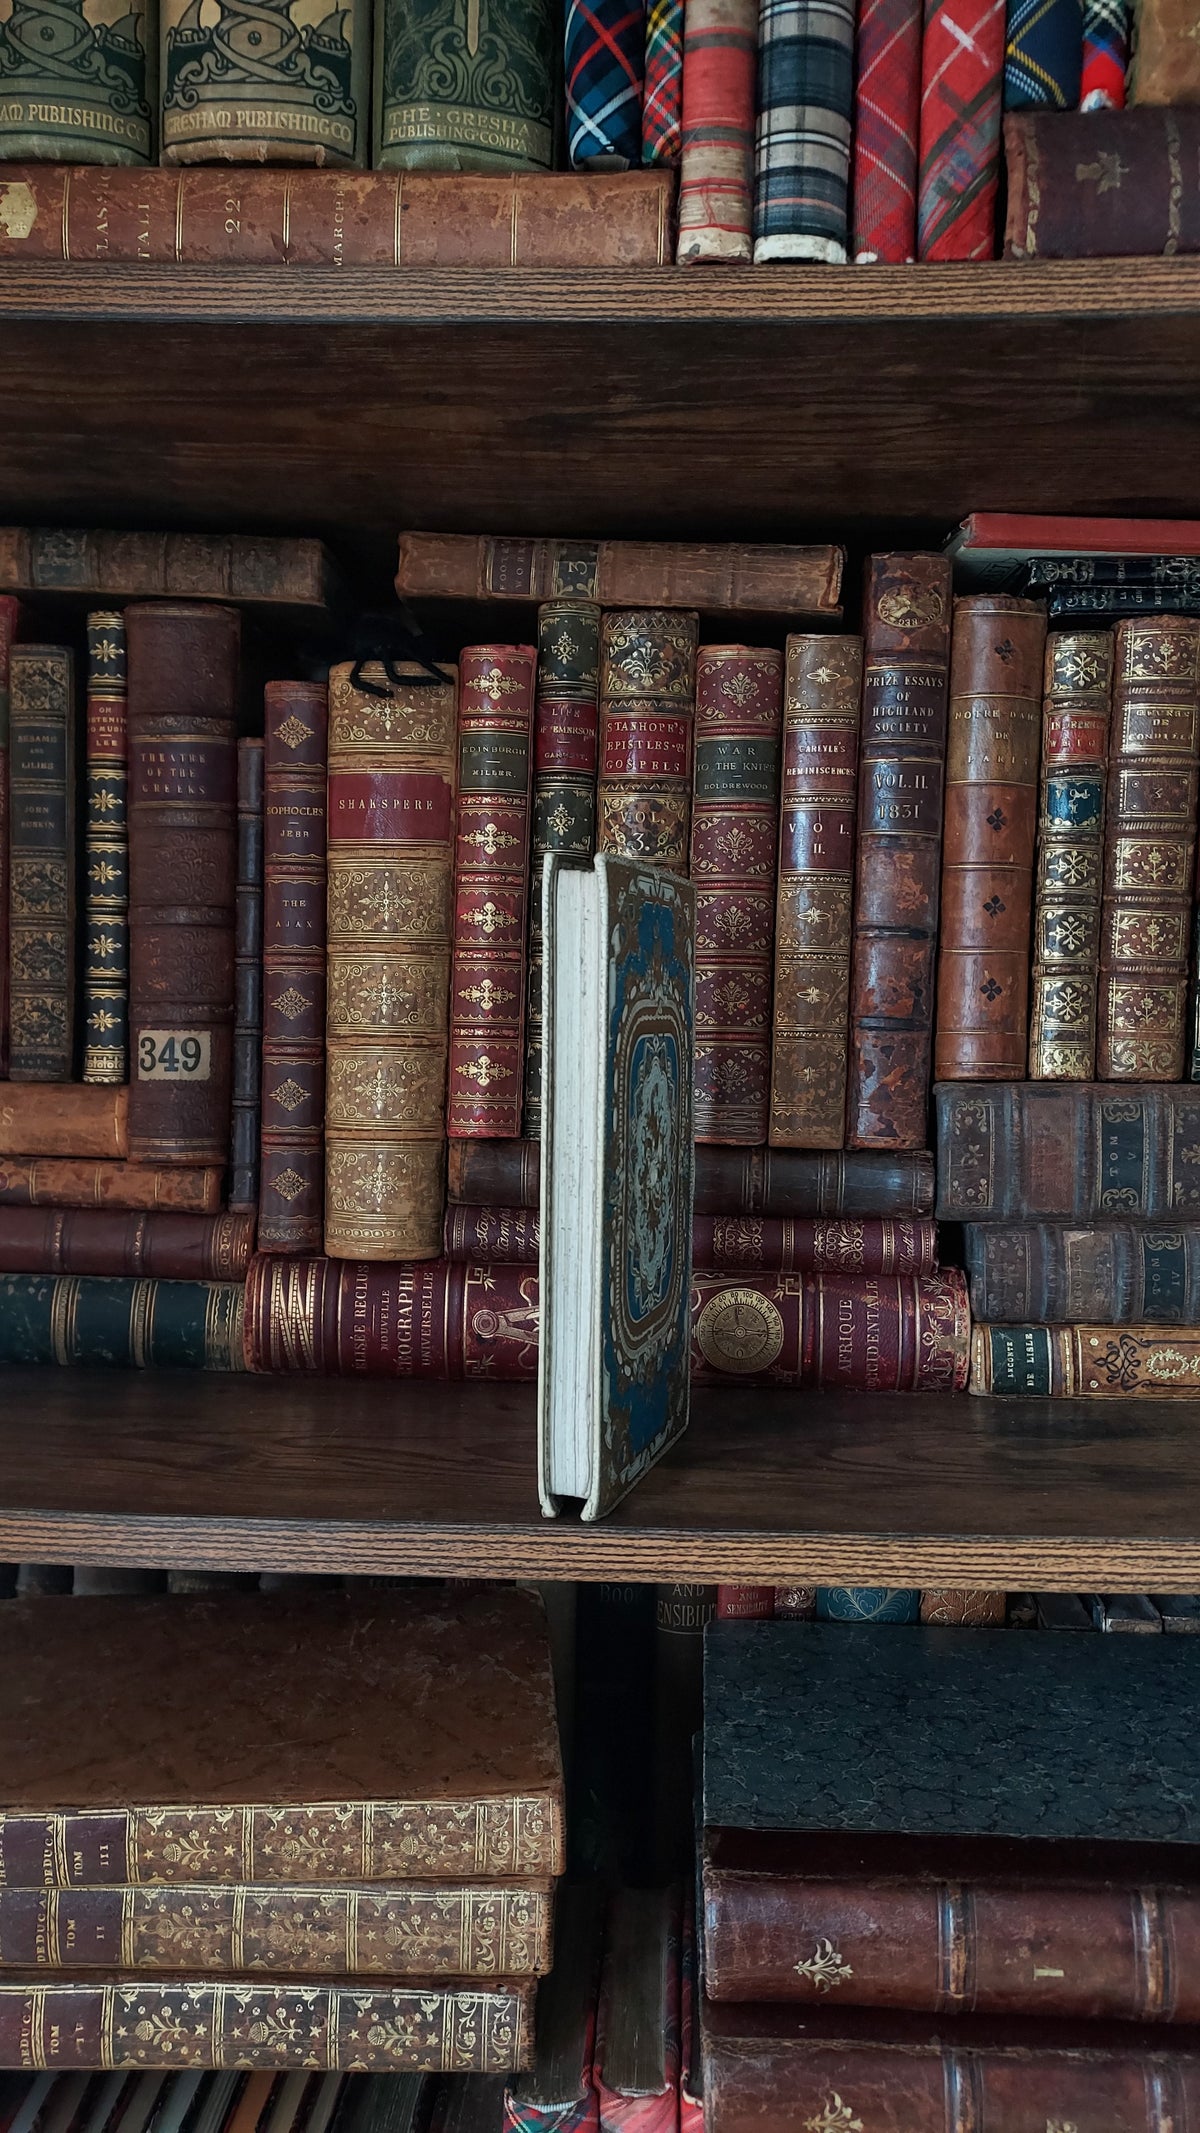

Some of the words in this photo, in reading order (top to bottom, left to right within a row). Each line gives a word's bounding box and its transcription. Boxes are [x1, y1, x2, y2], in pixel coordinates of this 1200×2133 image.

[28, 104, 125, 134] PUBLISHING
[164, 110, 231, 135] GRESHAM
[236, 110, 330, 135] PUBLISHING
[331, 121, 351, 142] CO
[389, 107, 431, 125] THE
[446, 110, 542, 138] GRESHA
[389, 123, 475, 141] PUBLISHING
[866, 675, 898, 687] PRIZE
[904, 675, 943, 687] ESSAYS
[896, 691, 911, 701] OF
[872, 706, 934, 718] HIGHLAND
[607, 721, 685, 736] STANHOPE'S
[874, 722, 929, 733] SOCIETY
[462, 745, 527, 756] EDINBURGH
[606, 740, 670, 751] EPISTLES
[717, 746, 756, 756] WAR
[799, 741, 847, 754] CARLYLE'S
[606, 759, 681, 772] GOSPELS
[716, 762, 737, 771] THE
[146, 768, 163, 778] OF
[170, 768, 197, 778] THE
[141, 783, 207, 795] GREEKS
[704, 782, 768, 790] BOLDREWOOD
[266, 806, 324, 817] SOPHOCLES
[339, 799, 434, 811] SHAKSPERE
[878, 804, 920, 819] 1831
[283, 899, 307, 908] THE
[275, 920, 313, 929] AJAX
[140, 1036, 201, 1072] 349
[1109, 1135, 1119, 1177] TOM
[355, 1264, 369, 1319] RECLUS
[381, 1289, 391, 1352] NOUVELLE
[421, 1271, 434, 1367] UNIVERSELLE
[838, 1299, 856, 1373] AFRIQUE
[1024, 1332, 1035, 1363] LISLE
[1025, 1373, 1035, 1387] DE
[672, 1583, 705, 1597] AND
[99, 1843, 110, 1867] III
[73, 1850, 84, 1878] TOM
[66, 1918, 77, 1949] TOM
[95, 1925, 105, 1940] II
[50, 2025, 60, 2056] TOM
